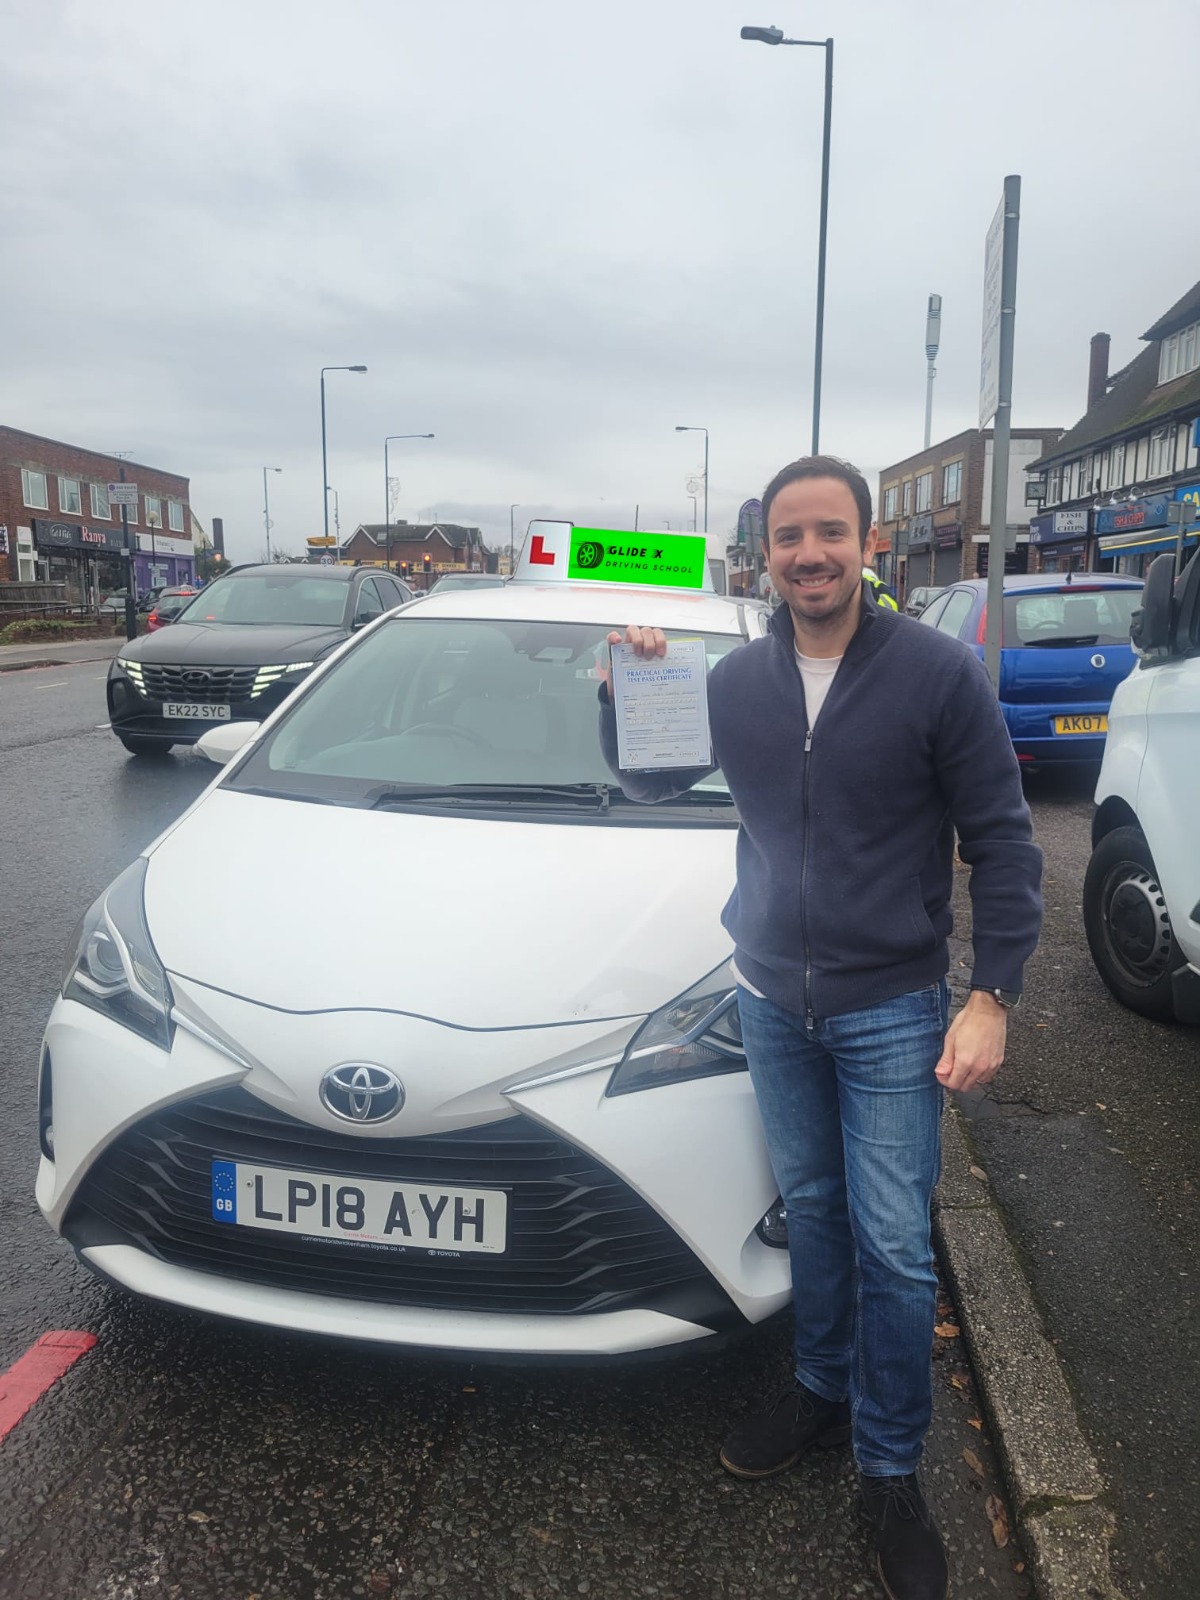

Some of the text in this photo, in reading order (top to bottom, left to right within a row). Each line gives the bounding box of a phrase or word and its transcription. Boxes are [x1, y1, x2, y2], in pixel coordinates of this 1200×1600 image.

[82, 526, 107, 547] Ranya
[529, 535, 555, 566] L
[608, 546, 664, 559] GLIDE X
[605, 560, 693, 574] DRIVING SCHOOL
[626, 667, 691, 677] PRACTICAL DRIVING
[168, 704, 225, 718] EK22 SYC
[1062, 716, 1102, 731] AK07
[215, 1198, 233, 1212] GB
[254, 1174, 485, 1243] LP18 AYH
[437, 1250, 460, 1258] TOYOTA
